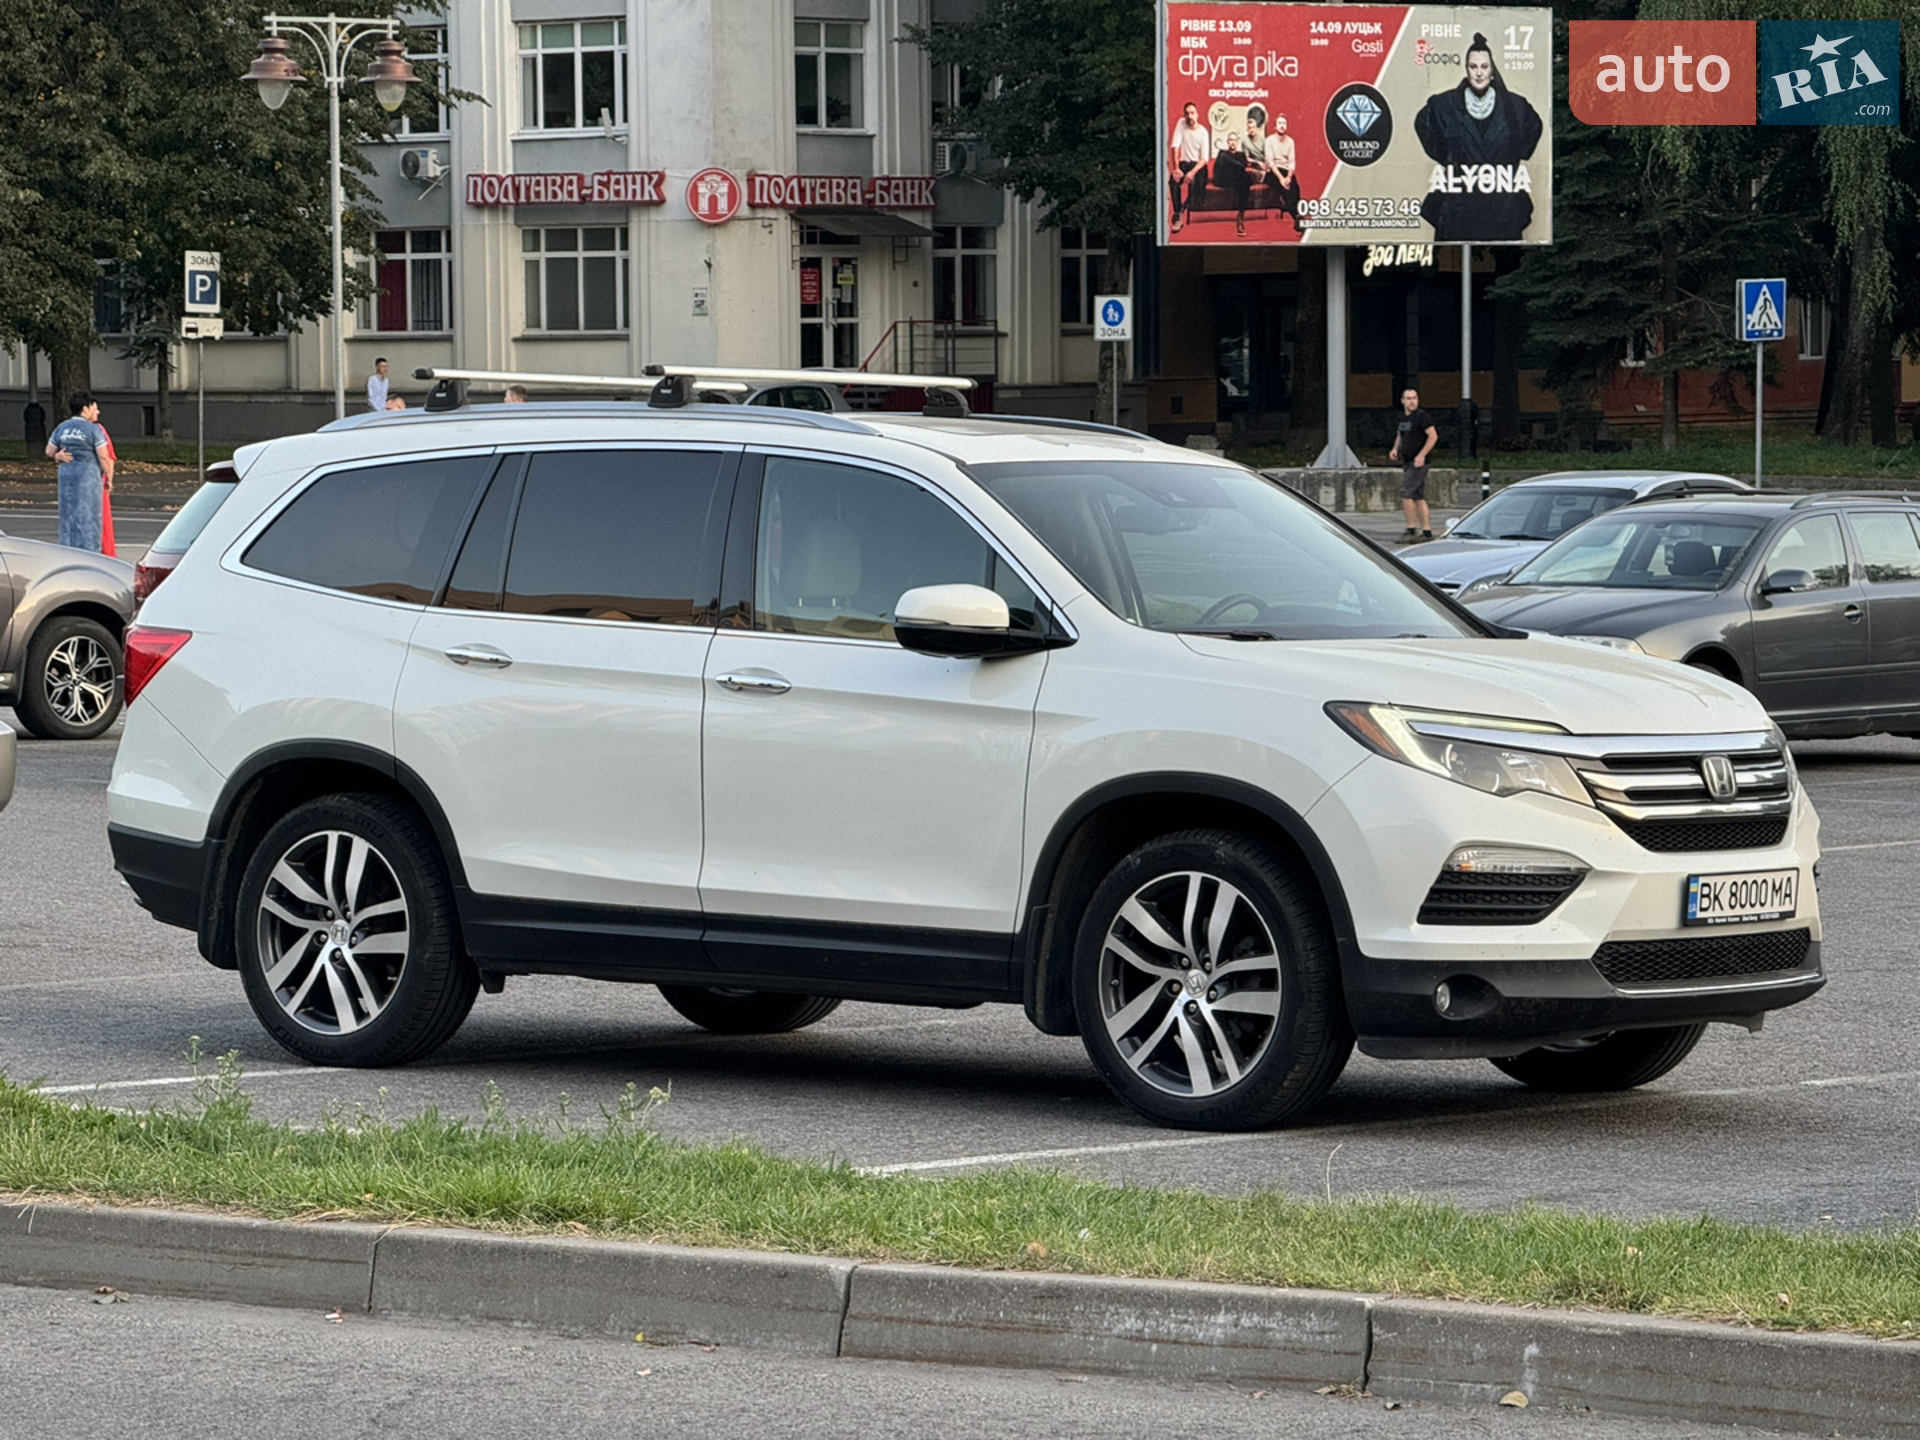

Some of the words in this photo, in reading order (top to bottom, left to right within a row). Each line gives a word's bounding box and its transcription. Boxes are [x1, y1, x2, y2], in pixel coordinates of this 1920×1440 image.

[1180, 19, 1216, 32] РІВНЕ
[1218, 20, 1252, 32] 13.09
[1309, 21, 1342, 33] 14.09
[1343, 21, 1382, 36] ЛУЦЬК
[1421, 23, 1462, 37] РІВНЕ
[1180, 36, 1208, 49] МБК
[1503, 25, 1534, 50] 17
[1351, 38, 1383, 53] Gosti
[1339, 140, 1380, 150] DIAMOND
[1428, 164, 1532, 193] ALYONA
[467, 174, 660, 203] ПОЛТАВА-БАНК
[754, 176, 936, 206] ПОЛТАВА-БАНК
[1297, 199, 1330, 216] 098
[1335, 199, 1369, 216] 445
[1372, 199, 1395, 216] 73
[1399, 199, 1421, 216] 46
[1299, 220, 1332, 228] КВИТКИ
[1332, 220, 1346, 228] ТУТ
[190, 255, 215, 266] ЗОНА
[195, 274, 212, 302] P
[1100, 328, 1126, 337] ЗОНА
[1699, 881, 1726, 912] BK
[1728, 878, 1769, 910] 8000
[1771, 876, 1792, 907] MA
